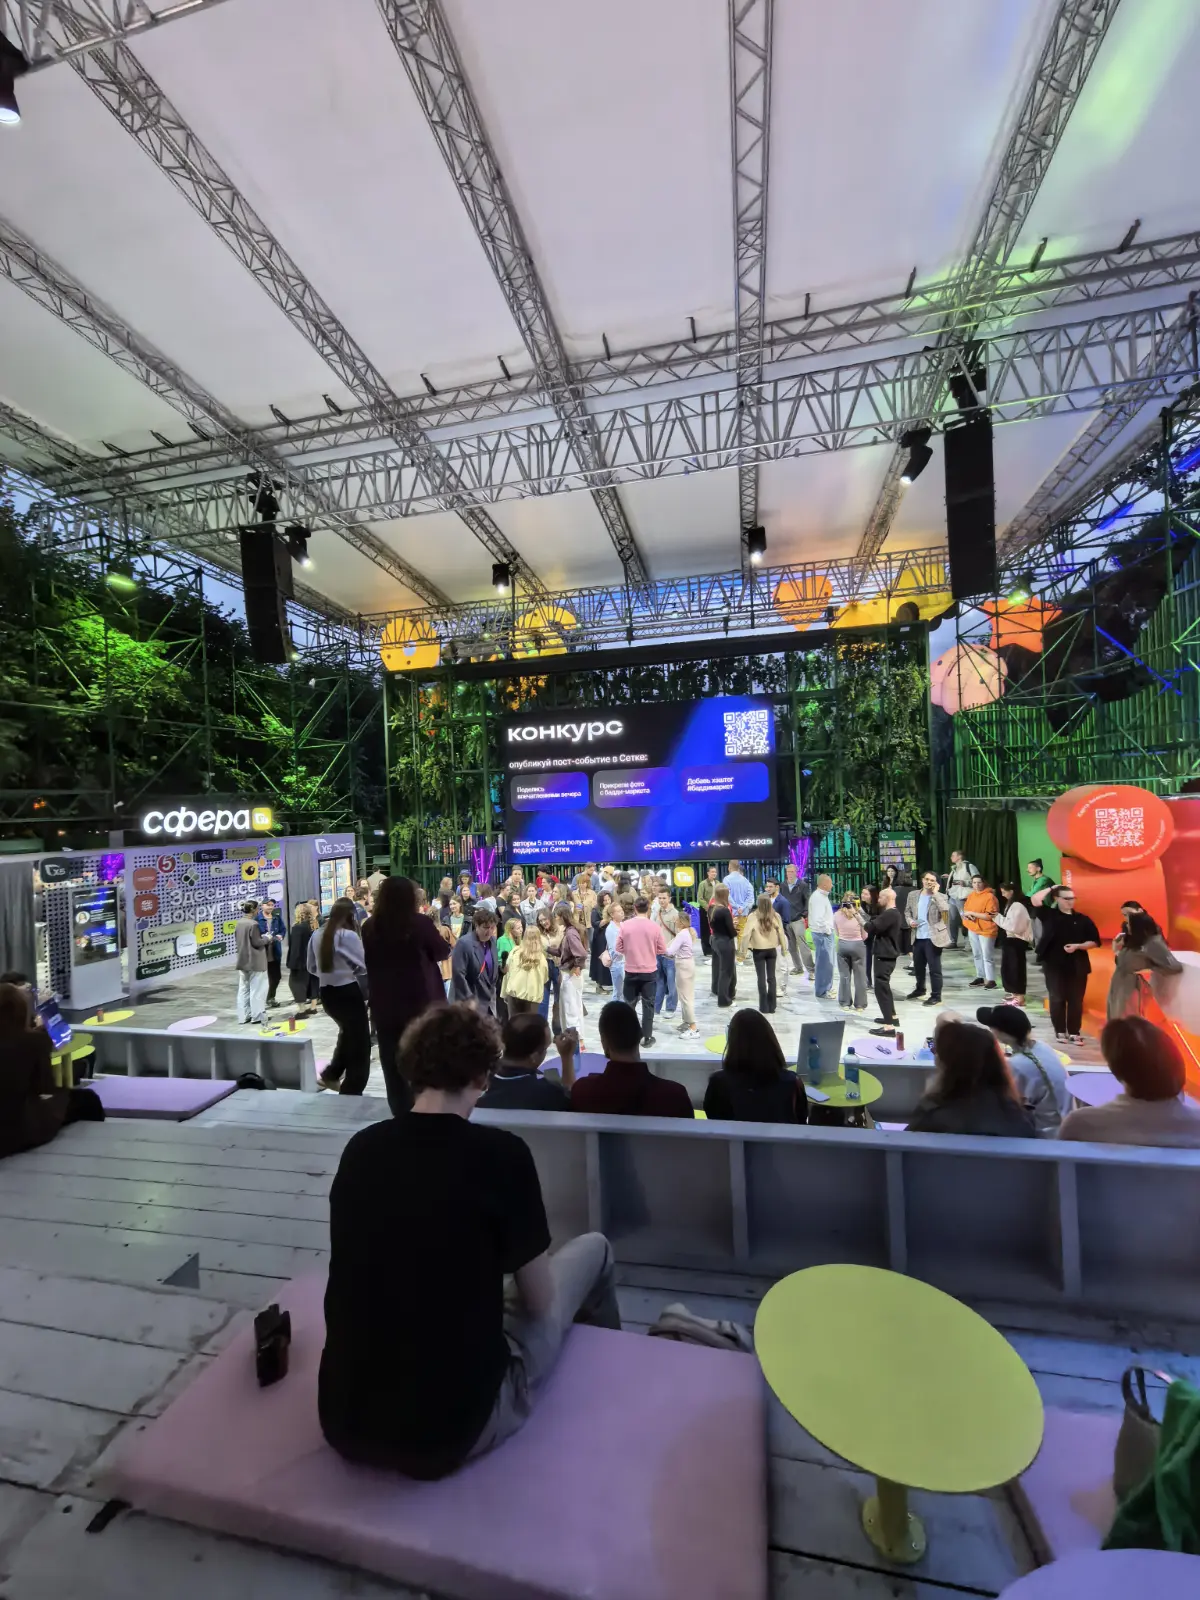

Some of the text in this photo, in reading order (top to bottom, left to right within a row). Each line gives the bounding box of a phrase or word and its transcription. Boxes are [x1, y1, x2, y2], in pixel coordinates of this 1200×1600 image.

[507, 720, 623, 742] конкурс
[509, 758, 551, 769] опубликуй
[552, 756, 611, 767] пост-событие
[619, 754, 649, 762] Сетке:
[687, 777, 711, 785] Добавь
[143, 806, 250, 837] сфера
[513, 840, 537, 848] авторы
[566, 838, 594, 847] получат
[170, 886, 225, 907] Здесь
[229, 882, 257, 897] все
[161, 902, 221, 925] вокруг
